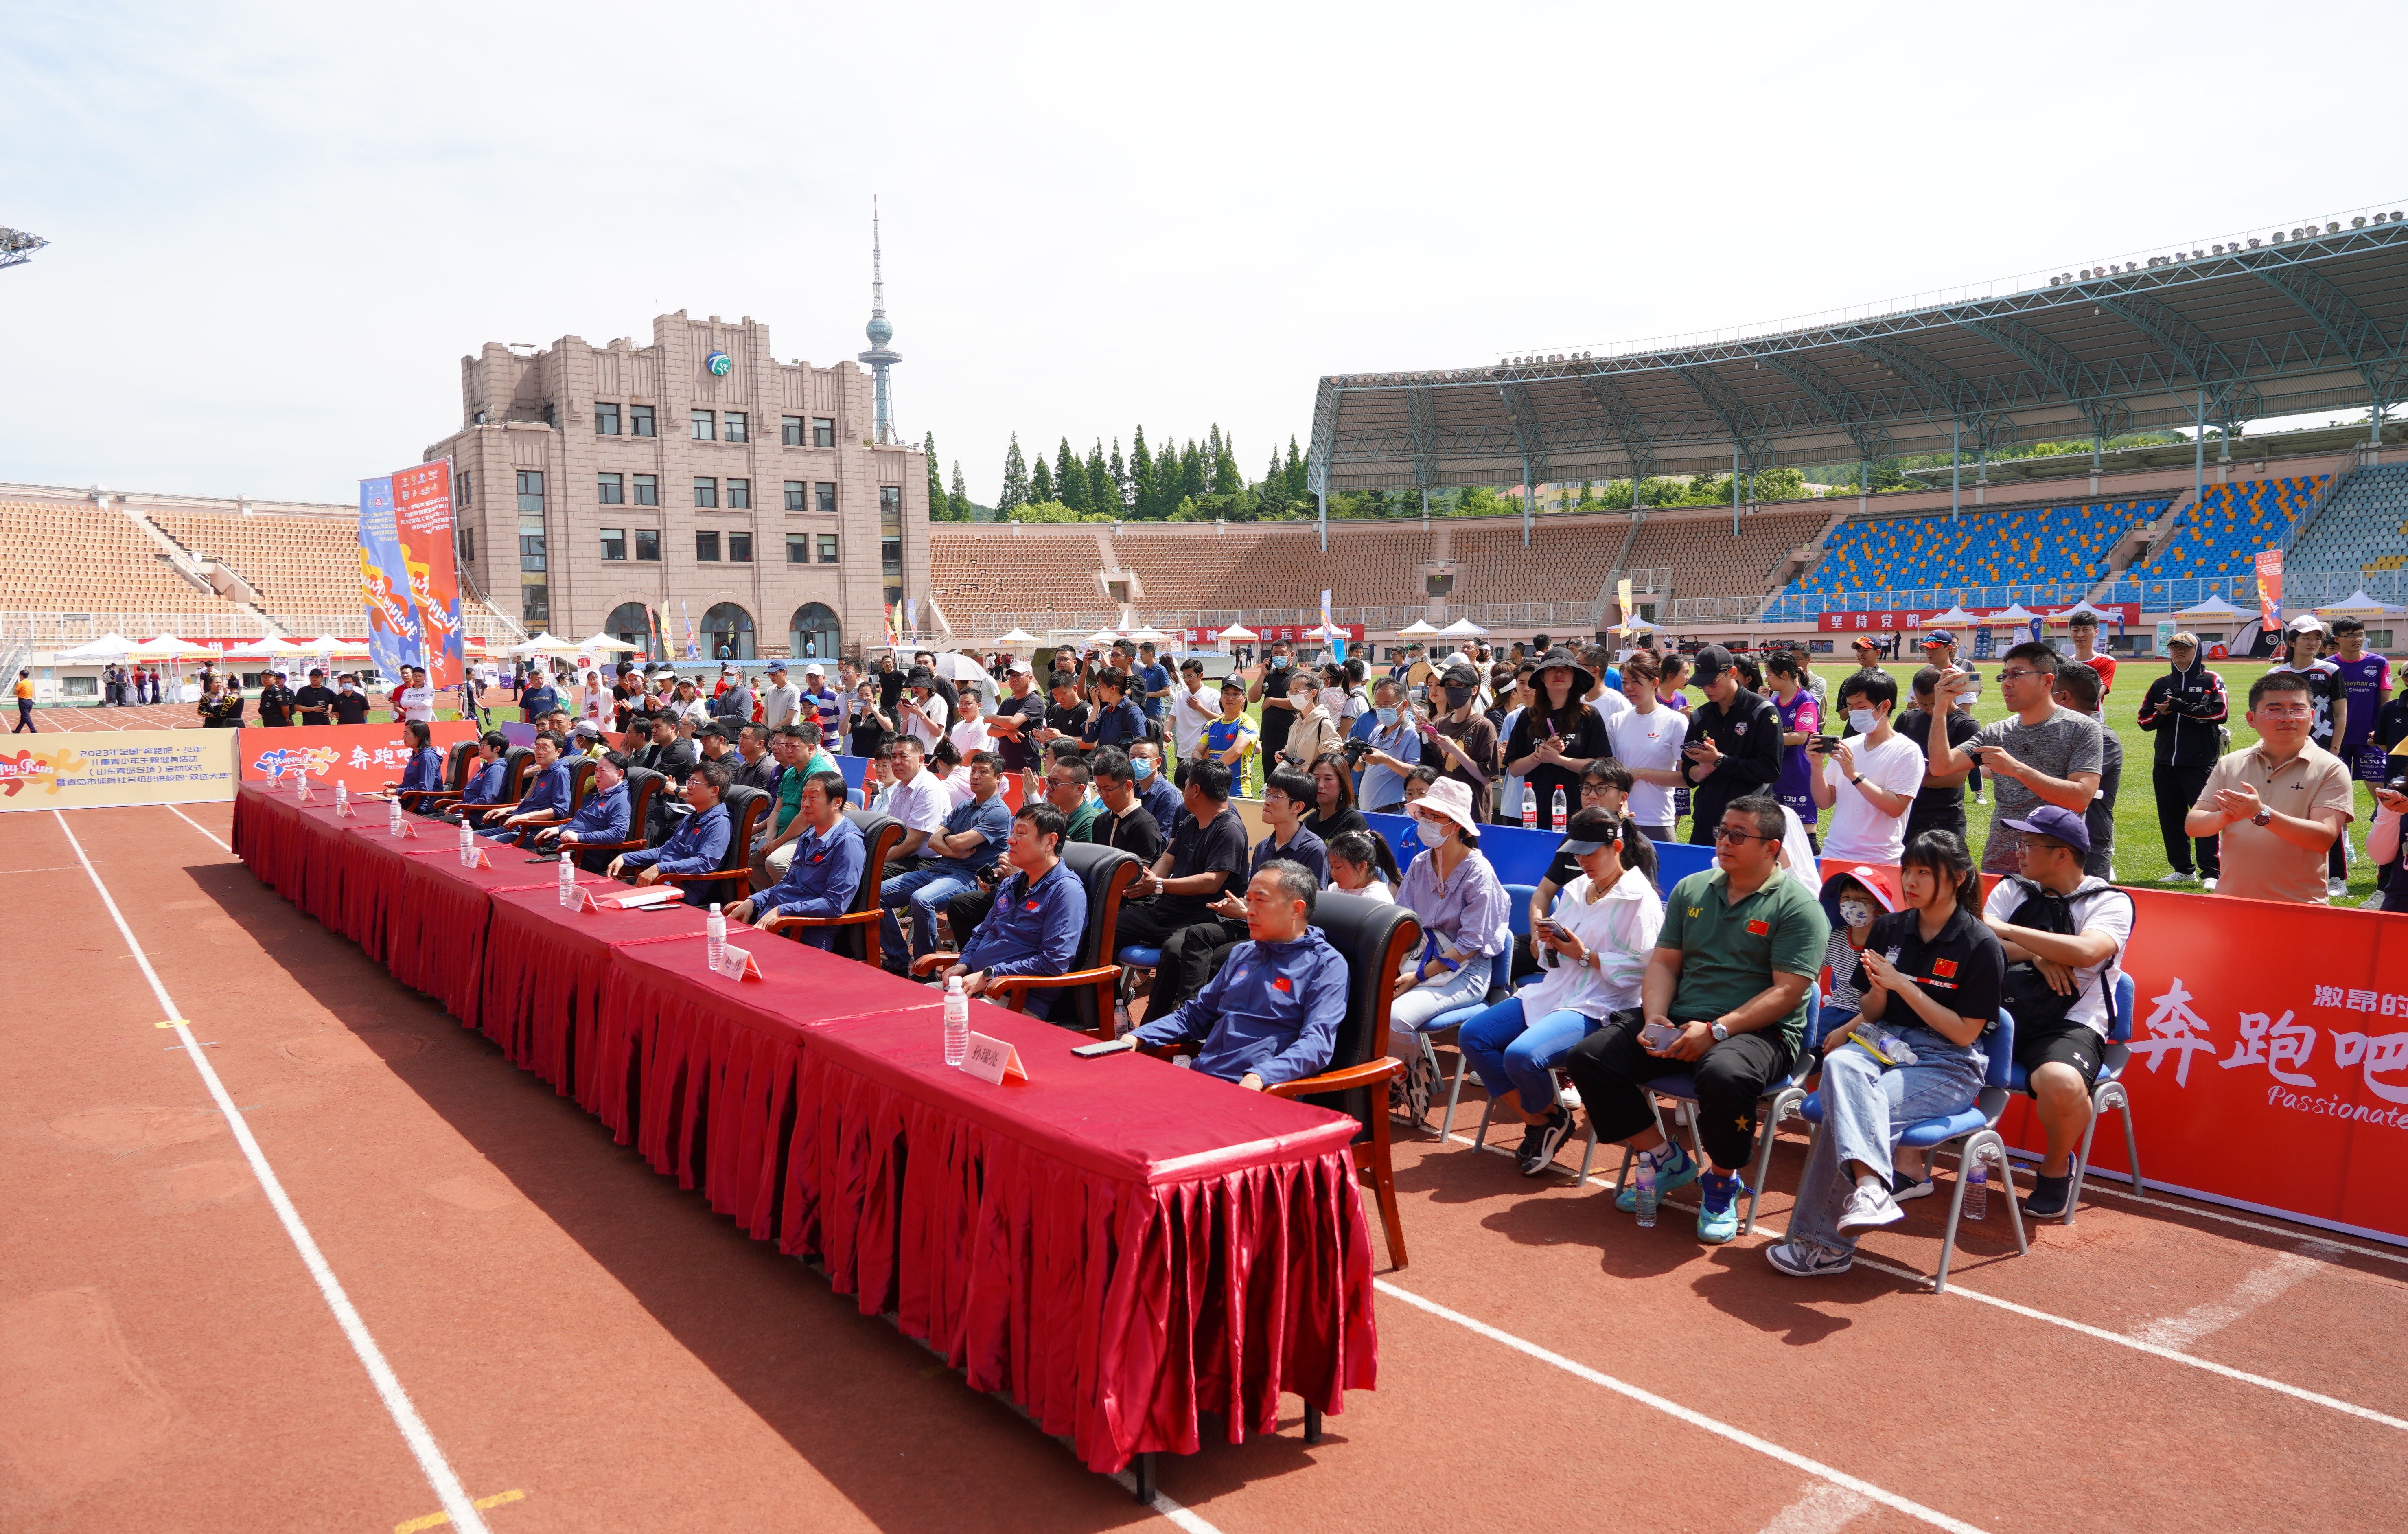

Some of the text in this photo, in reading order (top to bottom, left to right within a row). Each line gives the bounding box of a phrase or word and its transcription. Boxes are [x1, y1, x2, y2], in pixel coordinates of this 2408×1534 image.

[20, 758, 55, 775] Run
[92, 756, 198, 766] 儿童青少年主题健身活动
[274, 754, 322, 766] Happy Run
[2313, 984, 2408, 1017] 激昂的
[2130, 977, 2408, 1104] 奔跑吧
[2268, 1085, 2408, 1130] Passionate
